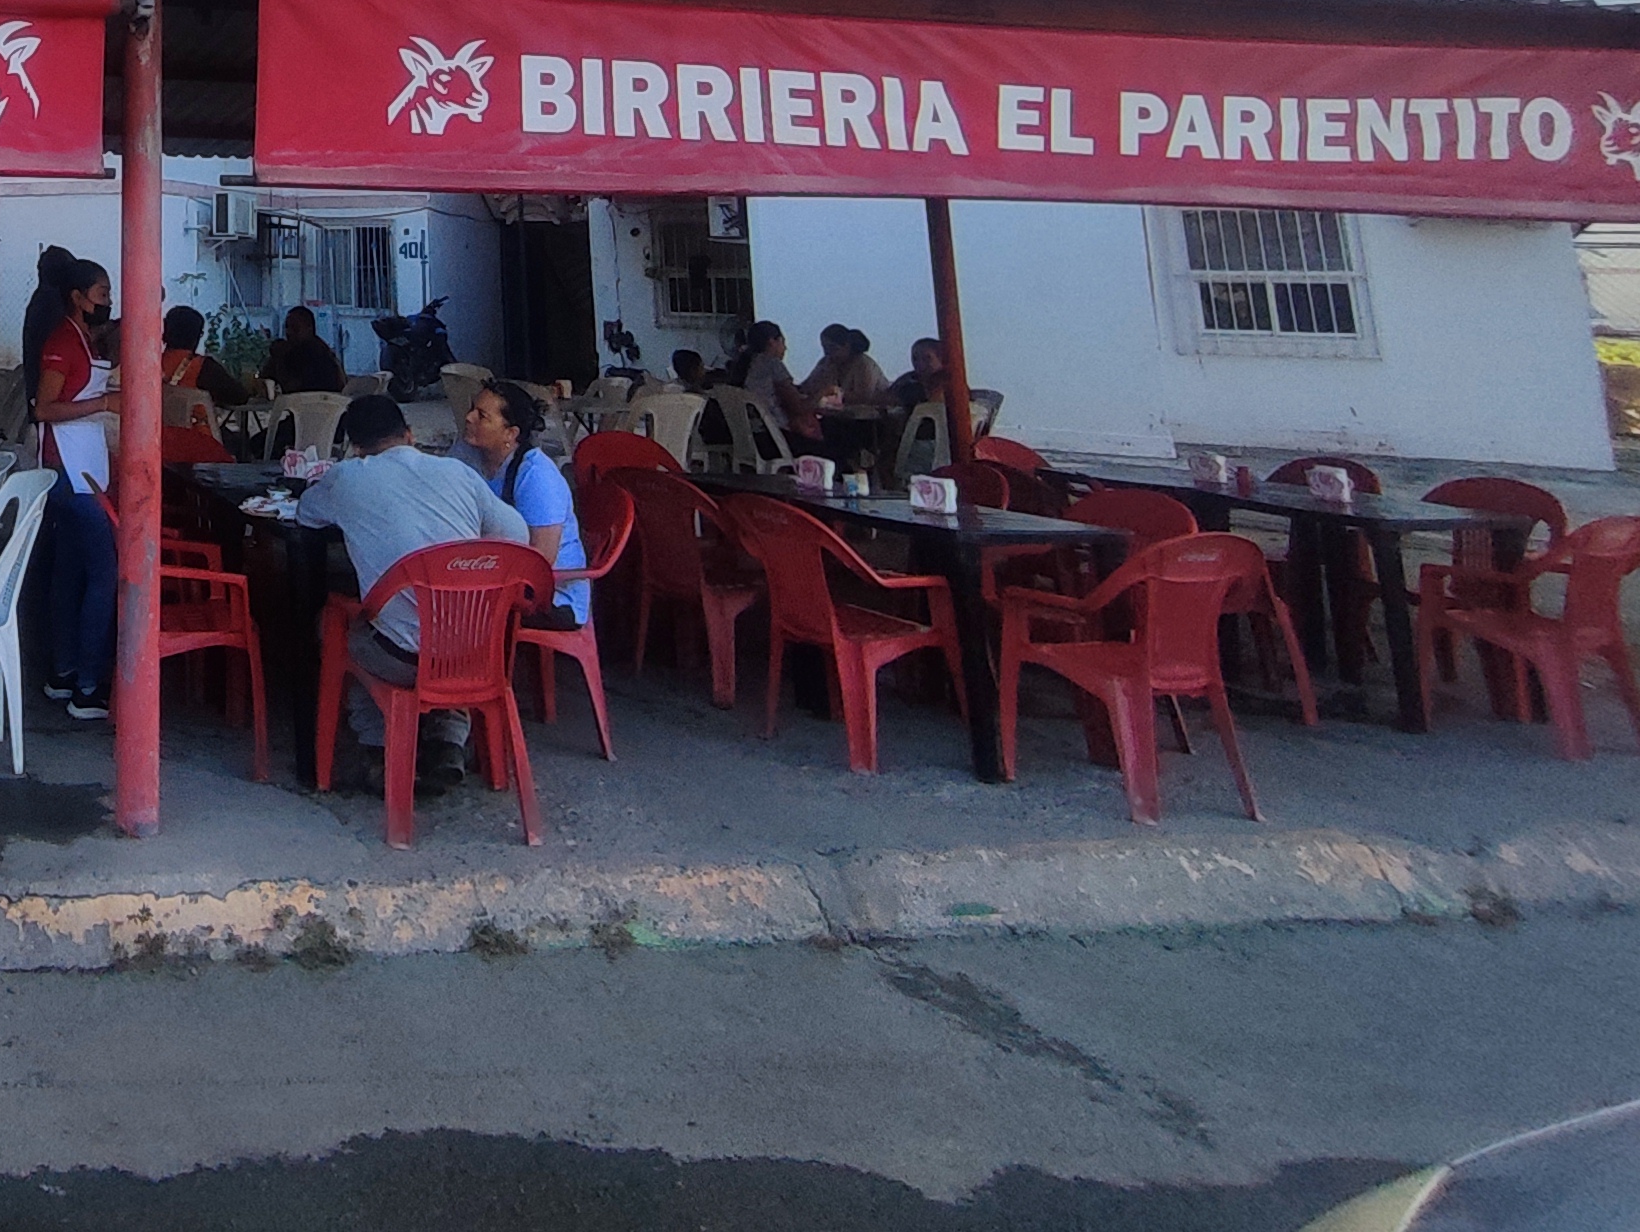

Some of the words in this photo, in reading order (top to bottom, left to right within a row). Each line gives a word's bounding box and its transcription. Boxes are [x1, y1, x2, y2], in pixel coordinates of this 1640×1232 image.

[520, 54, 969, 156] BIRRIERIA
[997, 83, 1095, 156] EL
[1118, 91, 1574, 163] PARIENTITO
